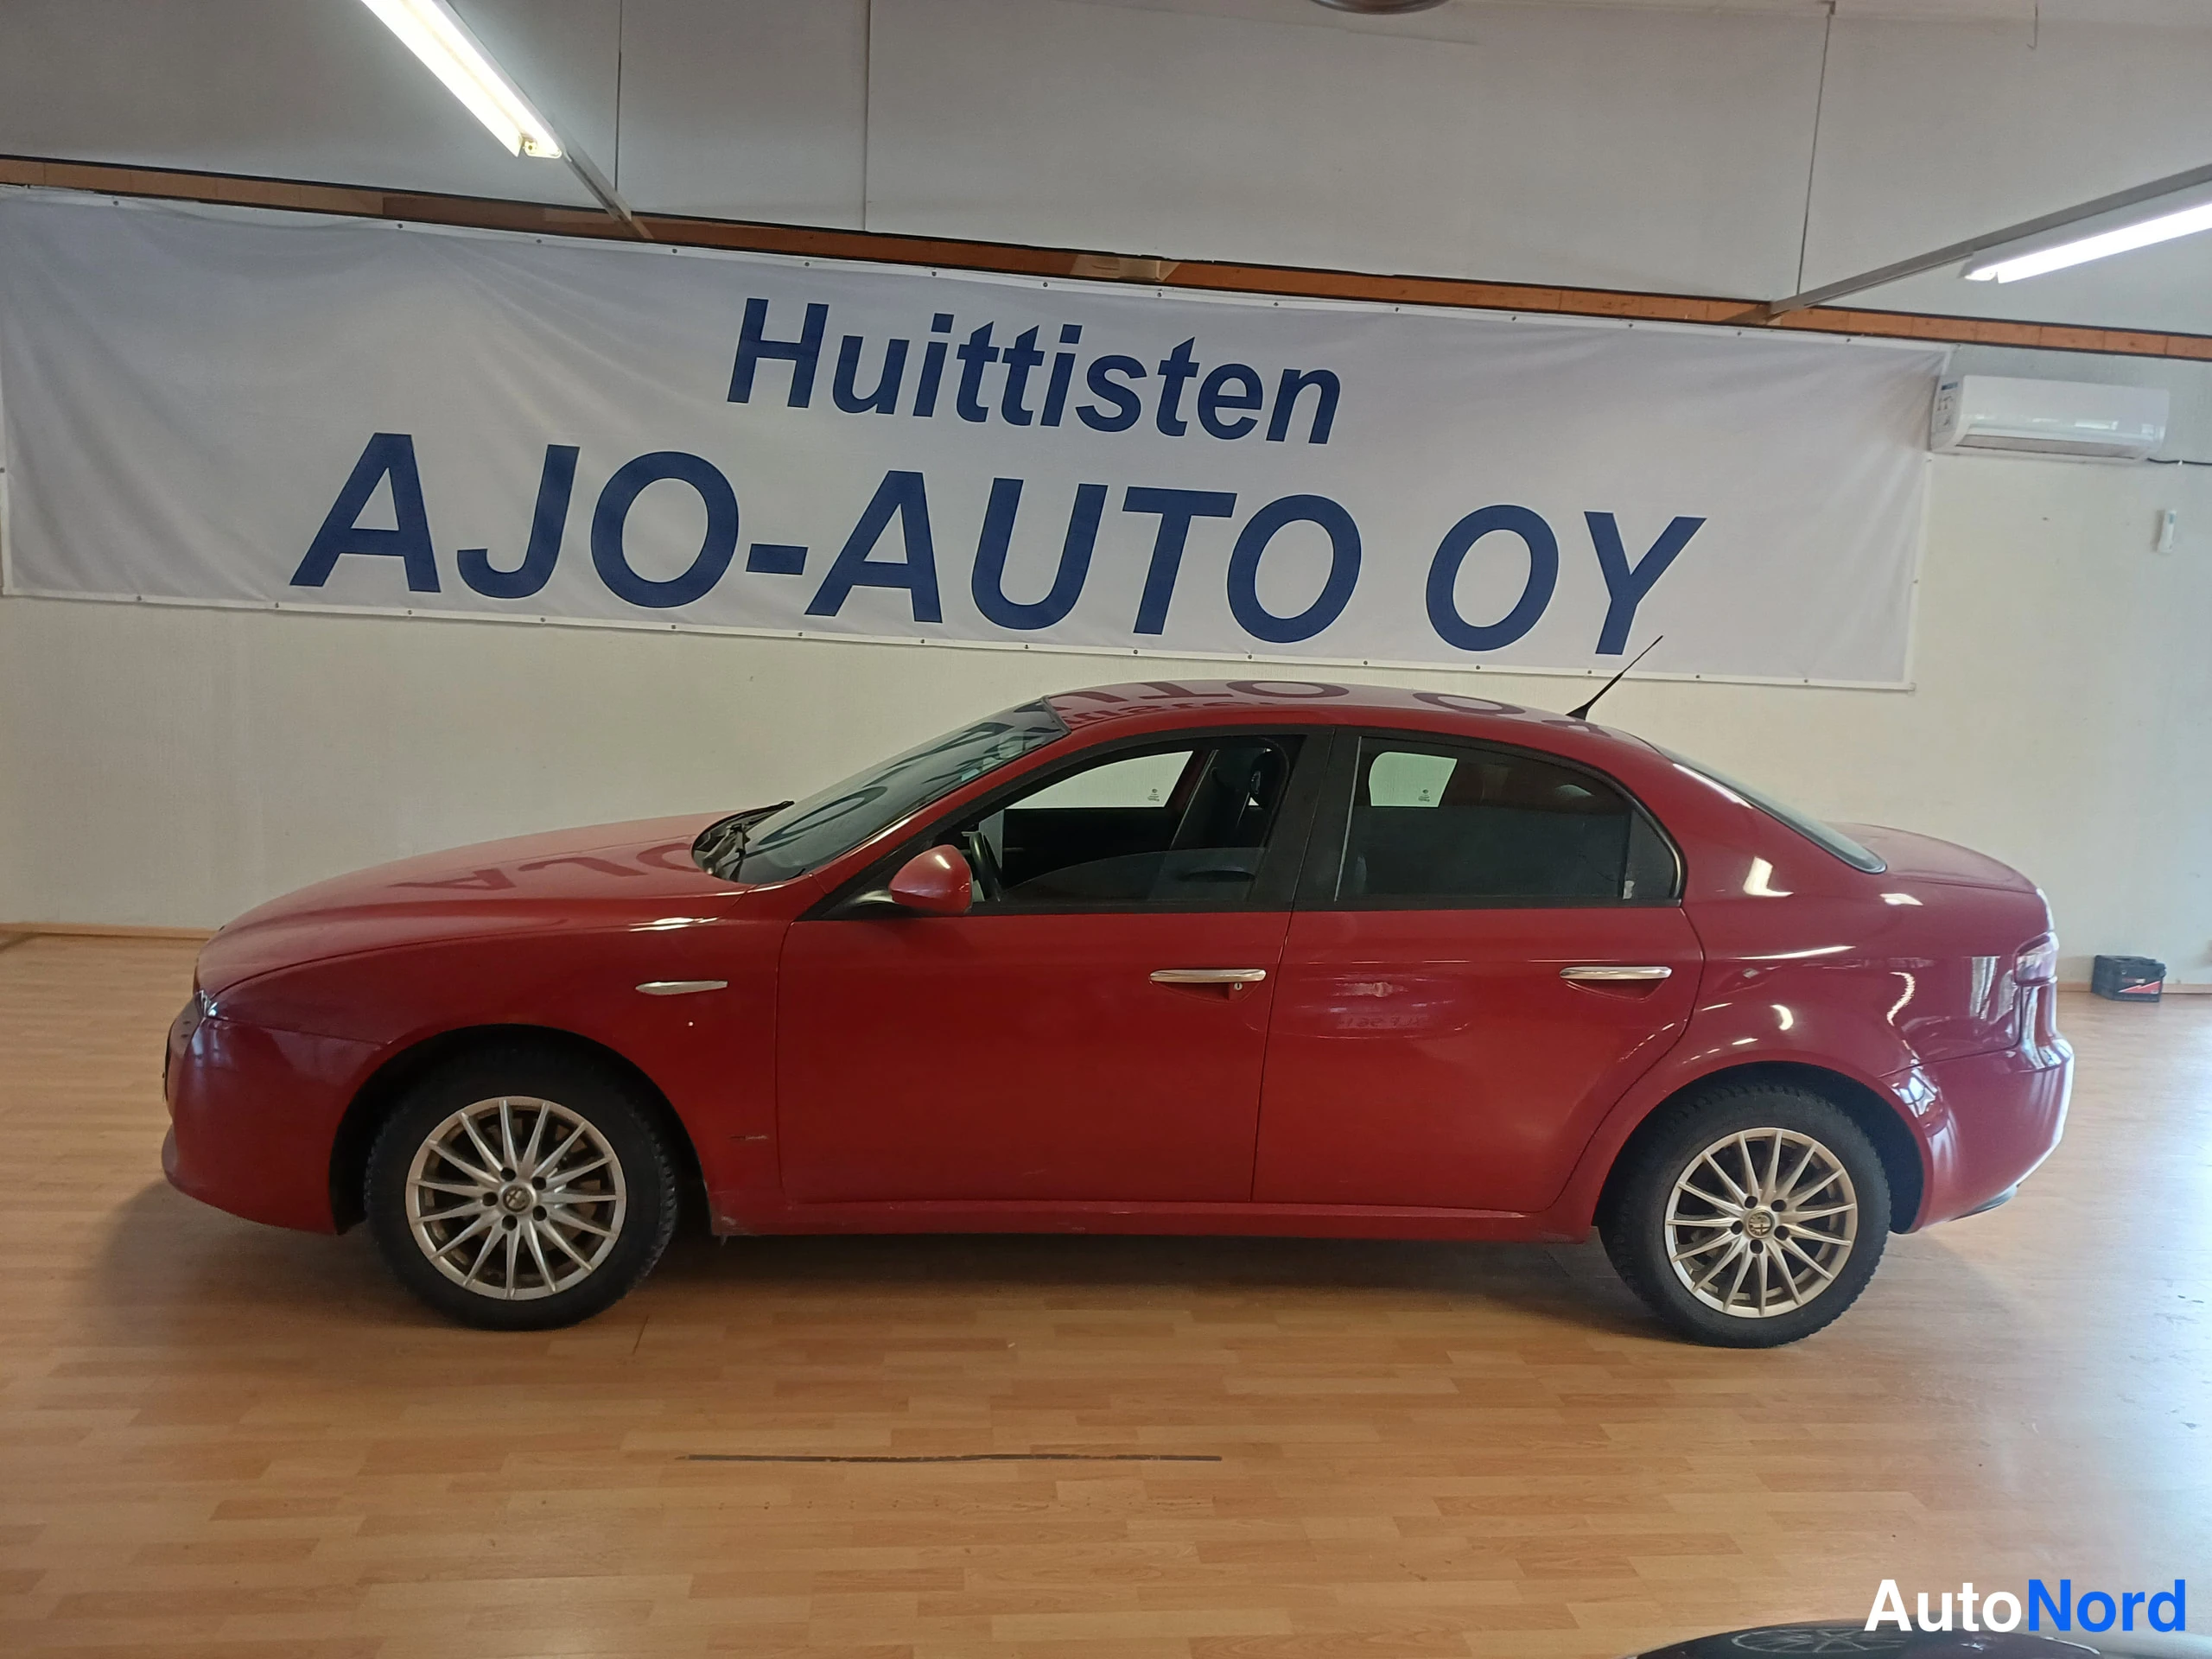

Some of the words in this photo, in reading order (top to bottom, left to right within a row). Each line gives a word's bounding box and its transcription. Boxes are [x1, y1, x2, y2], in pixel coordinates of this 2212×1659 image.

[727, 298, 1342, 445] Huittisten
[290, 433, 1362, 644] AJO-AUTO
[1426, 504, 1707, 656] OY
